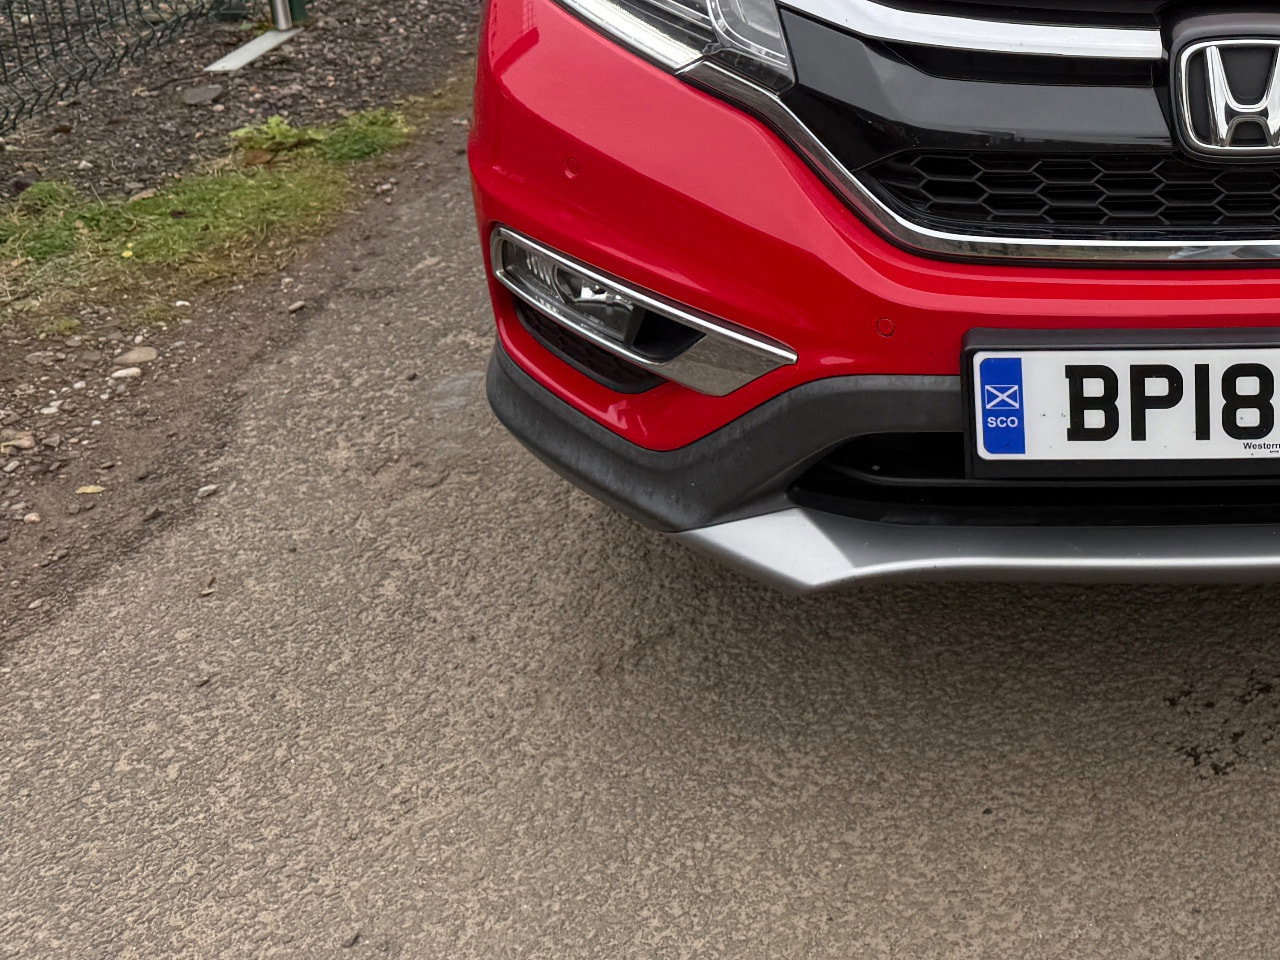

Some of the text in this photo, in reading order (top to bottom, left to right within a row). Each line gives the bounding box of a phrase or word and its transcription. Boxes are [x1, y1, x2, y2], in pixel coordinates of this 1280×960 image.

[1065, 363, 1275, 441] BP18
[987, 416, 1019, 428] SCO
[1243, 441, 1280, 449] Western
